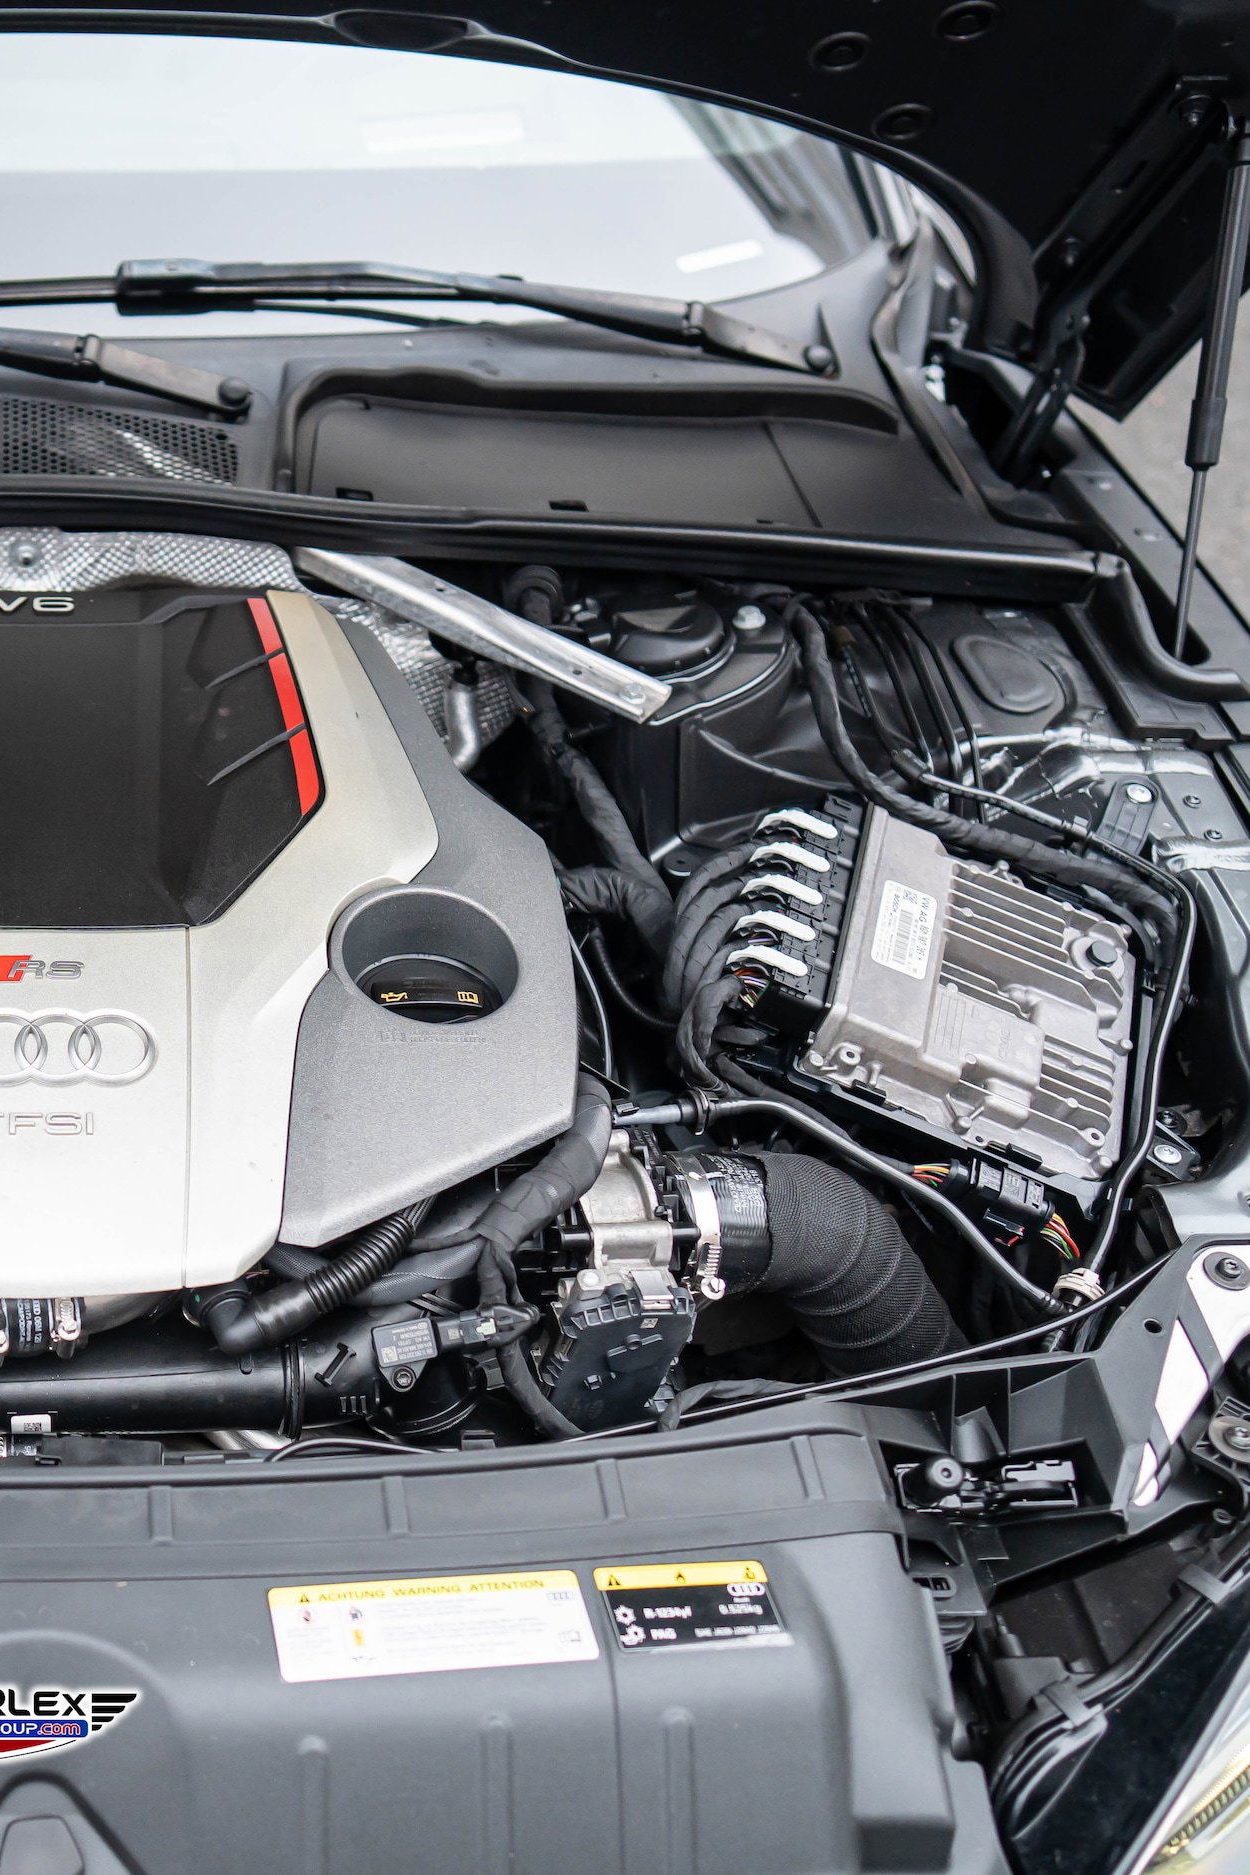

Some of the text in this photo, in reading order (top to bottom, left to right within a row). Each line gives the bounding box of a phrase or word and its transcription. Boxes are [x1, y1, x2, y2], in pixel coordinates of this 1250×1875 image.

[918, 910, 928, 923] AG
[5, 958, 85, 980] RS
[318, 1579, 545, 1602] ACHTUNG WARNING ATTENTION
